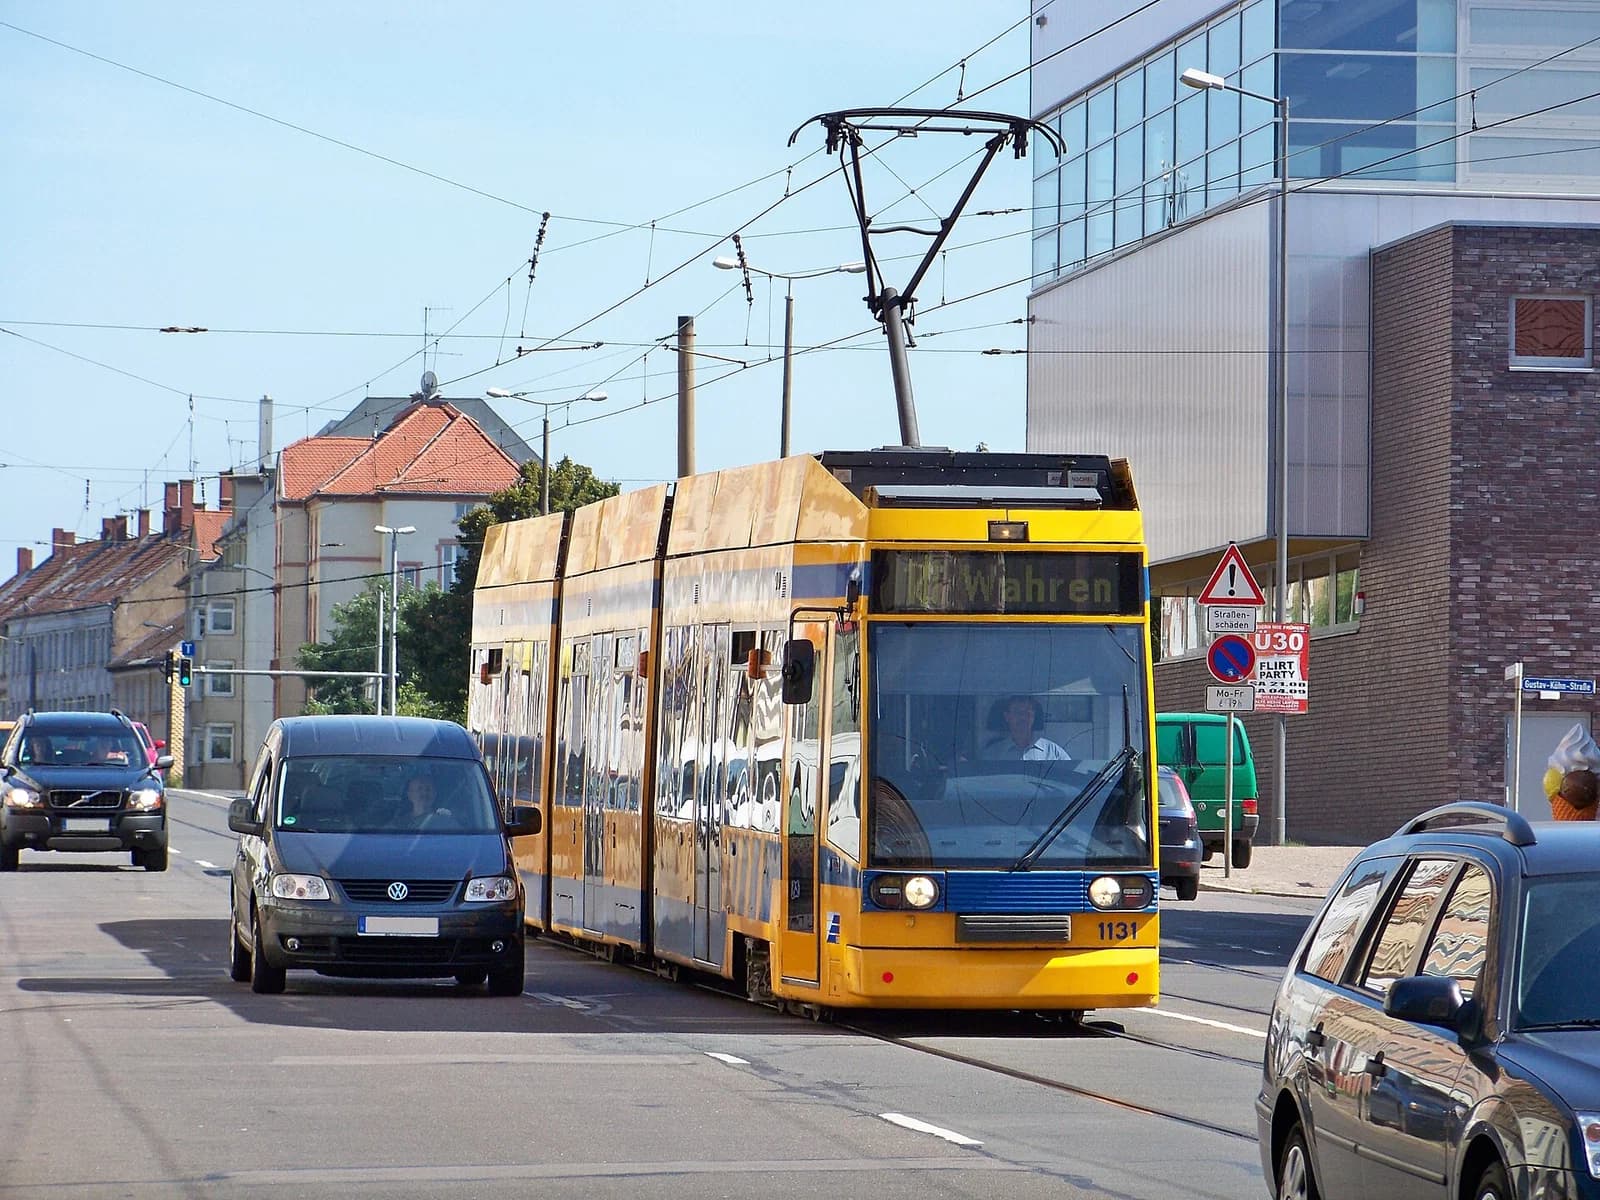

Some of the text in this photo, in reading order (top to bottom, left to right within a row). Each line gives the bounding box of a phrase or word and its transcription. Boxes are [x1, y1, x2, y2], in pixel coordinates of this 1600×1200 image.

[959, 563, 1112, 604] Wahren
[1214, 610, 1250, 619] Straßen-
[1255, 629, 1303, 651] Ü30
[184, 643, 193, 654] T
[1259, 661, 1295, 670] FLIRT
[1259, 670, 1295, 679] PARTY
[1216, 689, 1245, 698] Mo-Fr
[388, 882, 408, 900] VW
[1098, 922, 1137, 940] 1131
